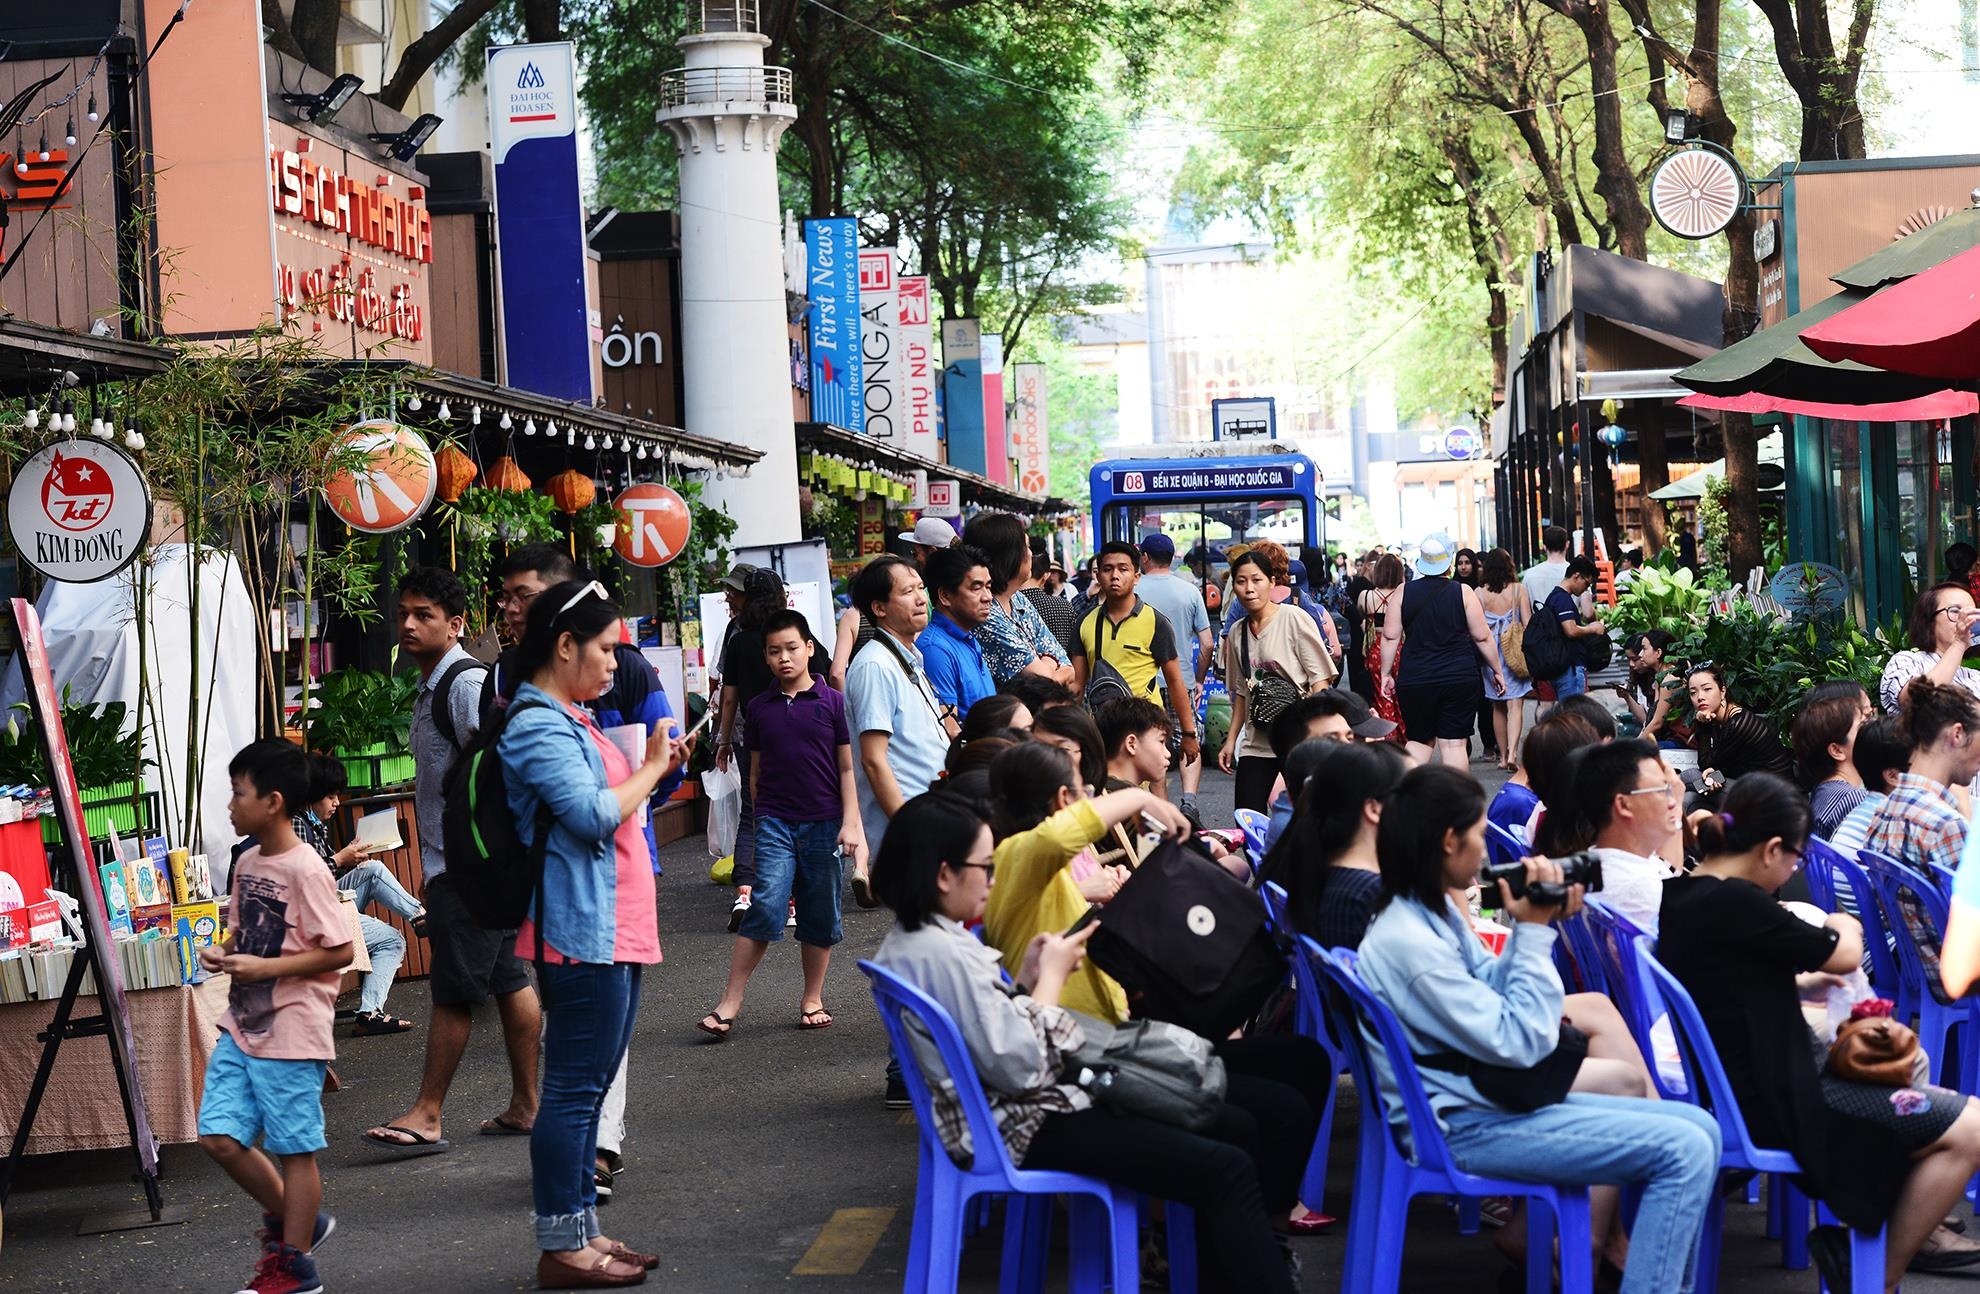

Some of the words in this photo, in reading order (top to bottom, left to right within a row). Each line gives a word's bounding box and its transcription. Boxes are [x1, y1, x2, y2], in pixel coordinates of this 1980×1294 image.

[511, 104, 533, 113] HOA
[534, 102, 554, 111] SEN
[844, 221, 856, 246] way
[812, 224, 836, 290] News
[848, 251, 855, 260] a
[844, 266, 856, 304] there's
[814, 295, 838, 351] First
[847, 320, 858, 344] will
[851, 343, 858, 353] a
[847, 357, 860, 397] there's
[848, 399, 862, 433] here
[1126, 475, 1142, 489] 08
[1153, 471, 1168, 488] BẾN
[1170, 475, 1180, 488] XE
[1181, 472, 1202, 490] QUẬN
[1204, 475, 1209, 487] 8
[1214, 474, 1228, 488] ĐẠI
[1228, 473, 1246, 488] HỌC
[1246, 467, 1268, 485] QUỐC
[1269, 471, 1283, 485] GIA
[863, 520, 884, 535] 20
[36, 531, 70, 563] KIM
[75, 528, 123, 562] ĐỒNG
[863, 541, 884, 555] 50
